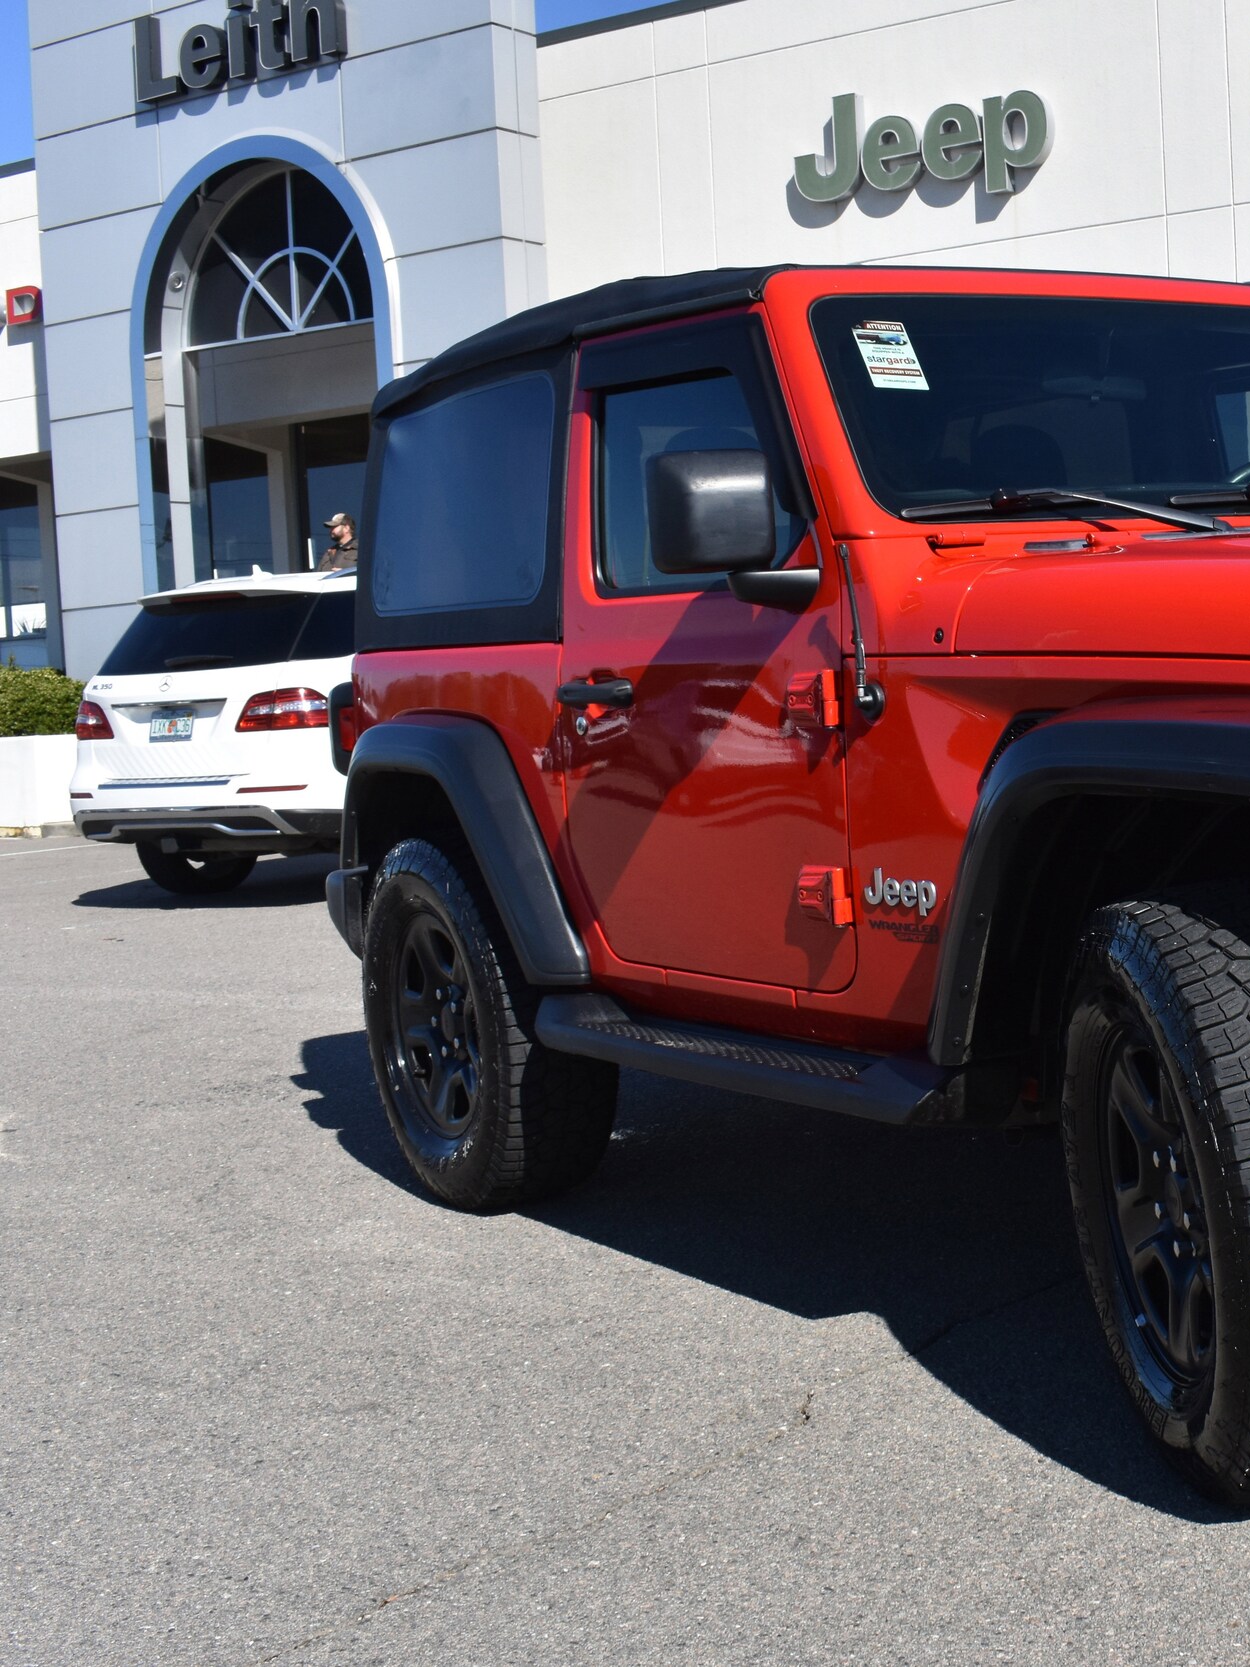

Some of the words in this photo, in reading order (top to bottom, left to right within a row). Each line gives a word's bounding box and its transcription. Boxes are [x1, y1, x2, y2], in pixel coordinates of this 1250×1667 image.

[133, 0, 347, 103] Leith
[793, 88, 1055, 203] Jeep
[866, 323, 902, 331] ATTENTION
[864, 867, 936, 916] Jeep
[868, 919, 939, 934] WRANGLER
